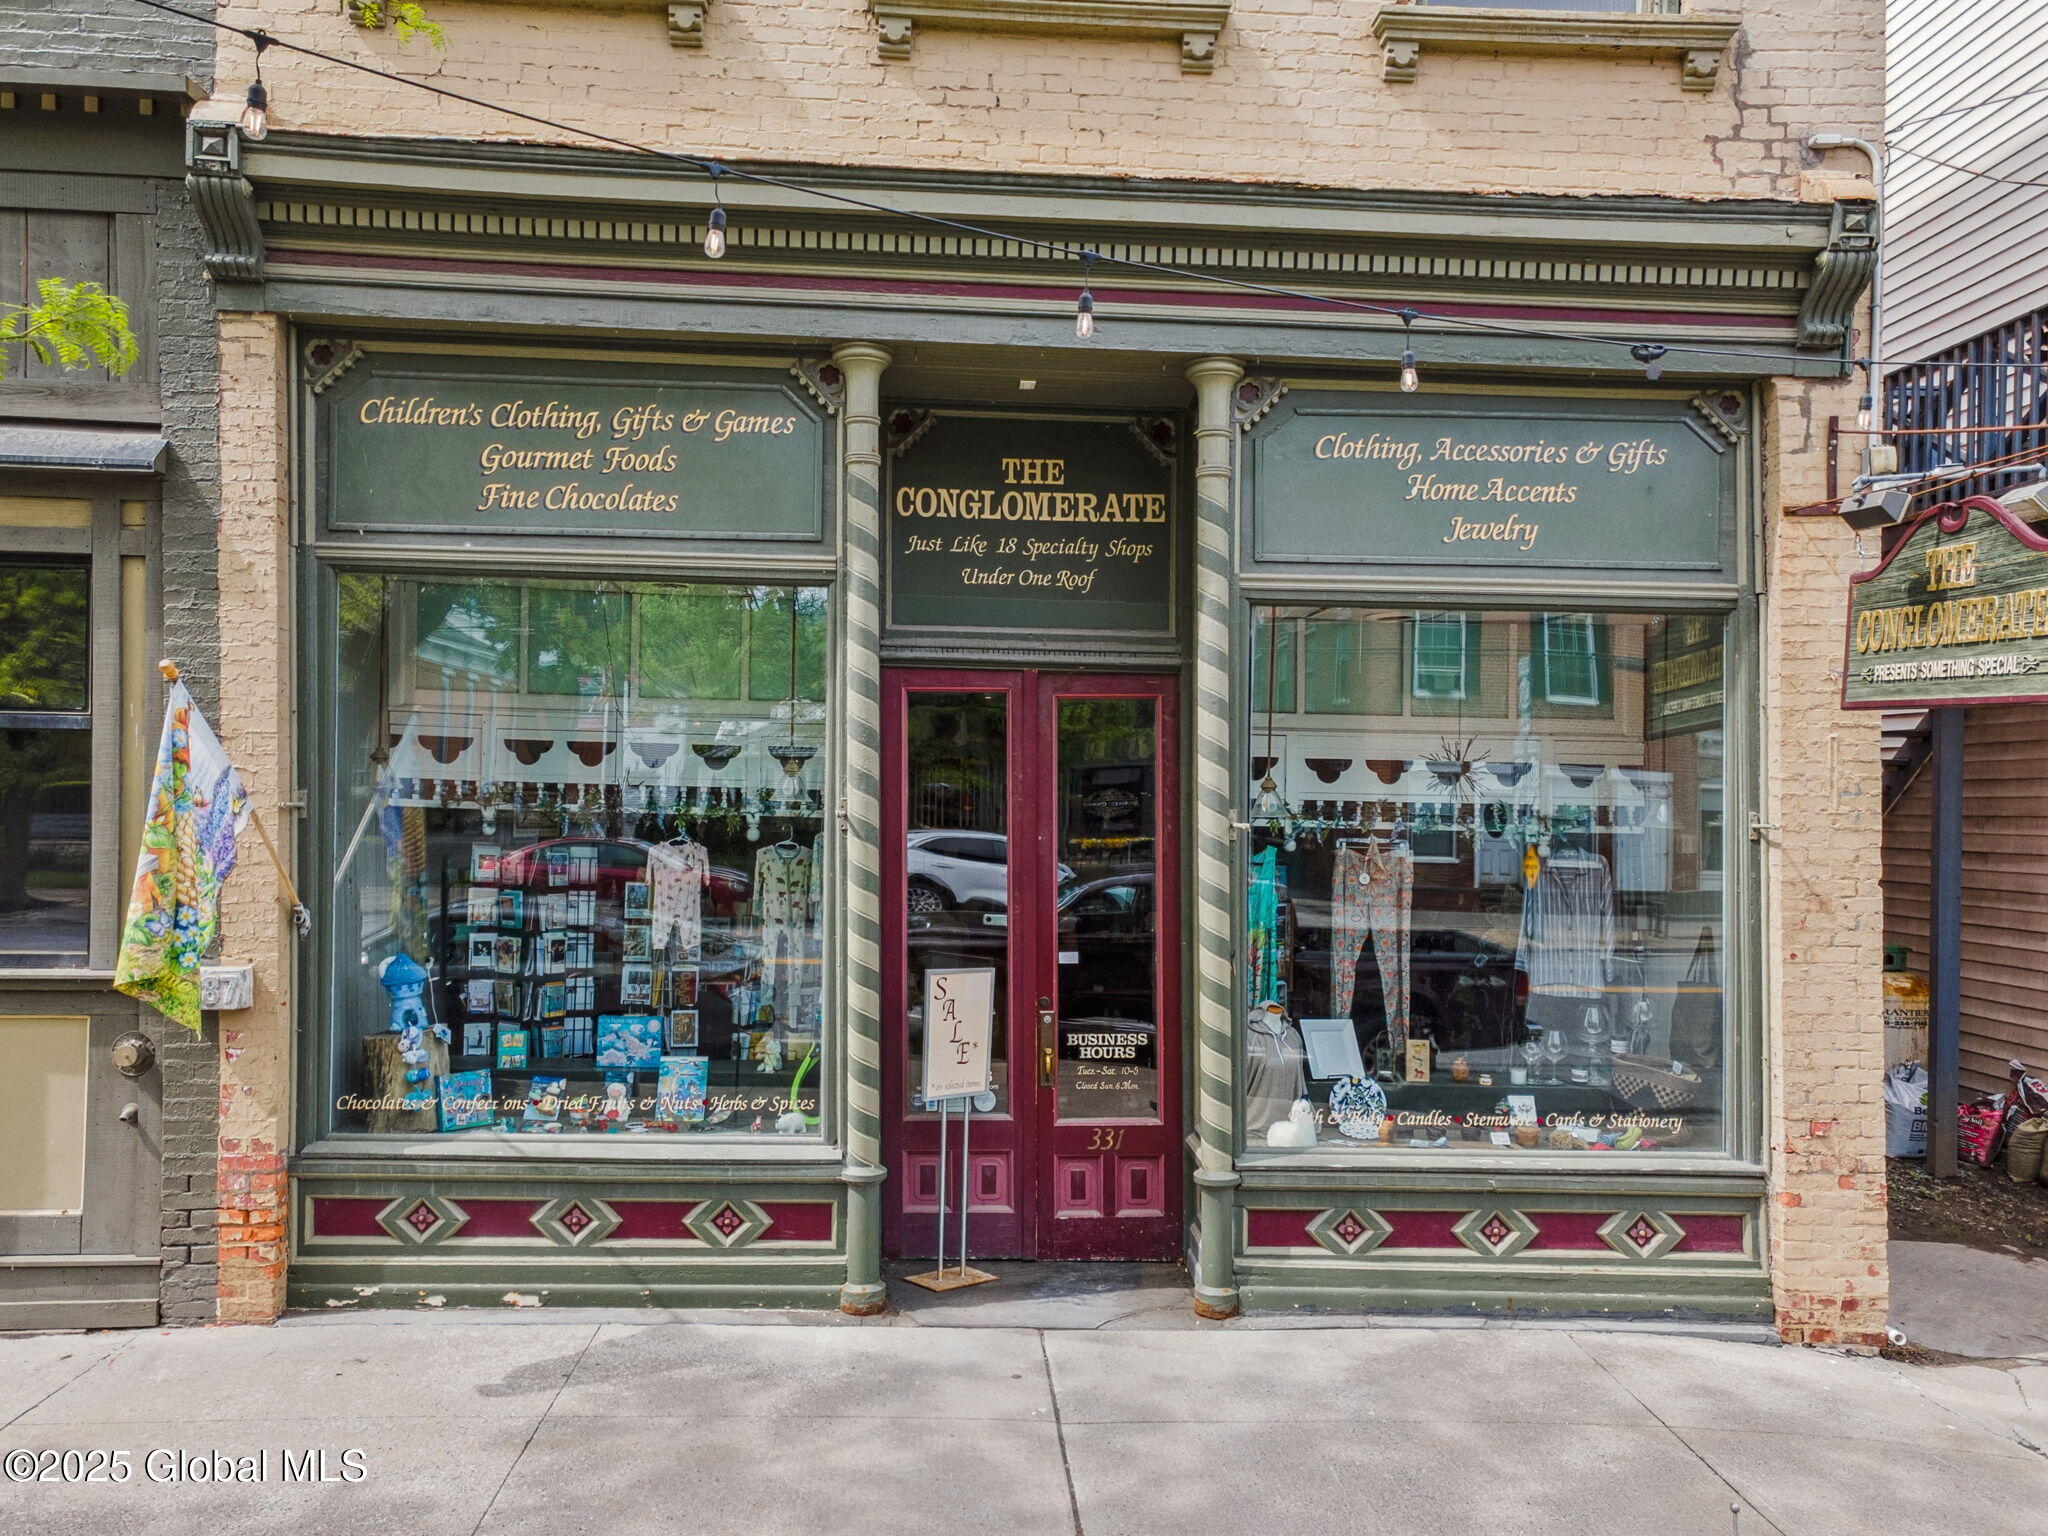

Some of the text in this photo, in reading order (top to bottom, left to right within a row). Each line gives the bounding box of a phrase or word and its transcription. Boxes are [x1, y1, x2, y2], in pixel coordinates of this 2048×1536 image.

[359, 397, 796, 442] Children's Clothing, Gifts & Games
[480, 444, 678, 475] Gourmet Foods
[1314, 433, 1668, 474] Clothing, Accessories & Gifts
[1002, 458, 1065, 485] THE
[476, 484, 678, 513] Fine Chocolates
[1404, 474, 1578, 504] Home Accents
[896, 486, 1166, 523] CONGLOMERATE
[1443, 514, 1540, 551] Jewelry
[905, 534, 1153, 563] Just Like 18 Specialty Shops
[961, 567, 1097, 594] Under One Roof
[1925, 542, 1977, 592] THE
[1856, 588, 2048, 654] CONGLOMERATE
[1874, 656, 2020, 682] PRESENTS SOMETHING SPECIAL
[1067, 1033, 1148, 1046] BUSINESS
[1080, 1047, 1136, 1059] HOURS
[1075, 1081, 1098, 1090] Closed
[336, 1093, 417, 1110] Chocolates
[421, 1096, 439, 1110] &
[542, 1094, 586, 1111] Dried
[587, 1096, 636, 1112] Fruits
[640, 1096, 657, 1110] &
[660, 1095, 698, 1112] Nuts
[709, 1094, 748, 1111] Herbs
[751, 1096, 768, 1110] &
[768, 1094, 815, 1117] Spices
[1327, 1111, 1345, 1125] &
[1348, 1109, 1386, 1129] Body
[1397, 1110, 1452, 1127] Candles
[1545, 1111, 1585, 1127] Cards
[1588, 1115, 1606, 1128] &
[1607, 1113, 1683, 1134] Stationery
[1087, 1128, 1125, 1150] 331
